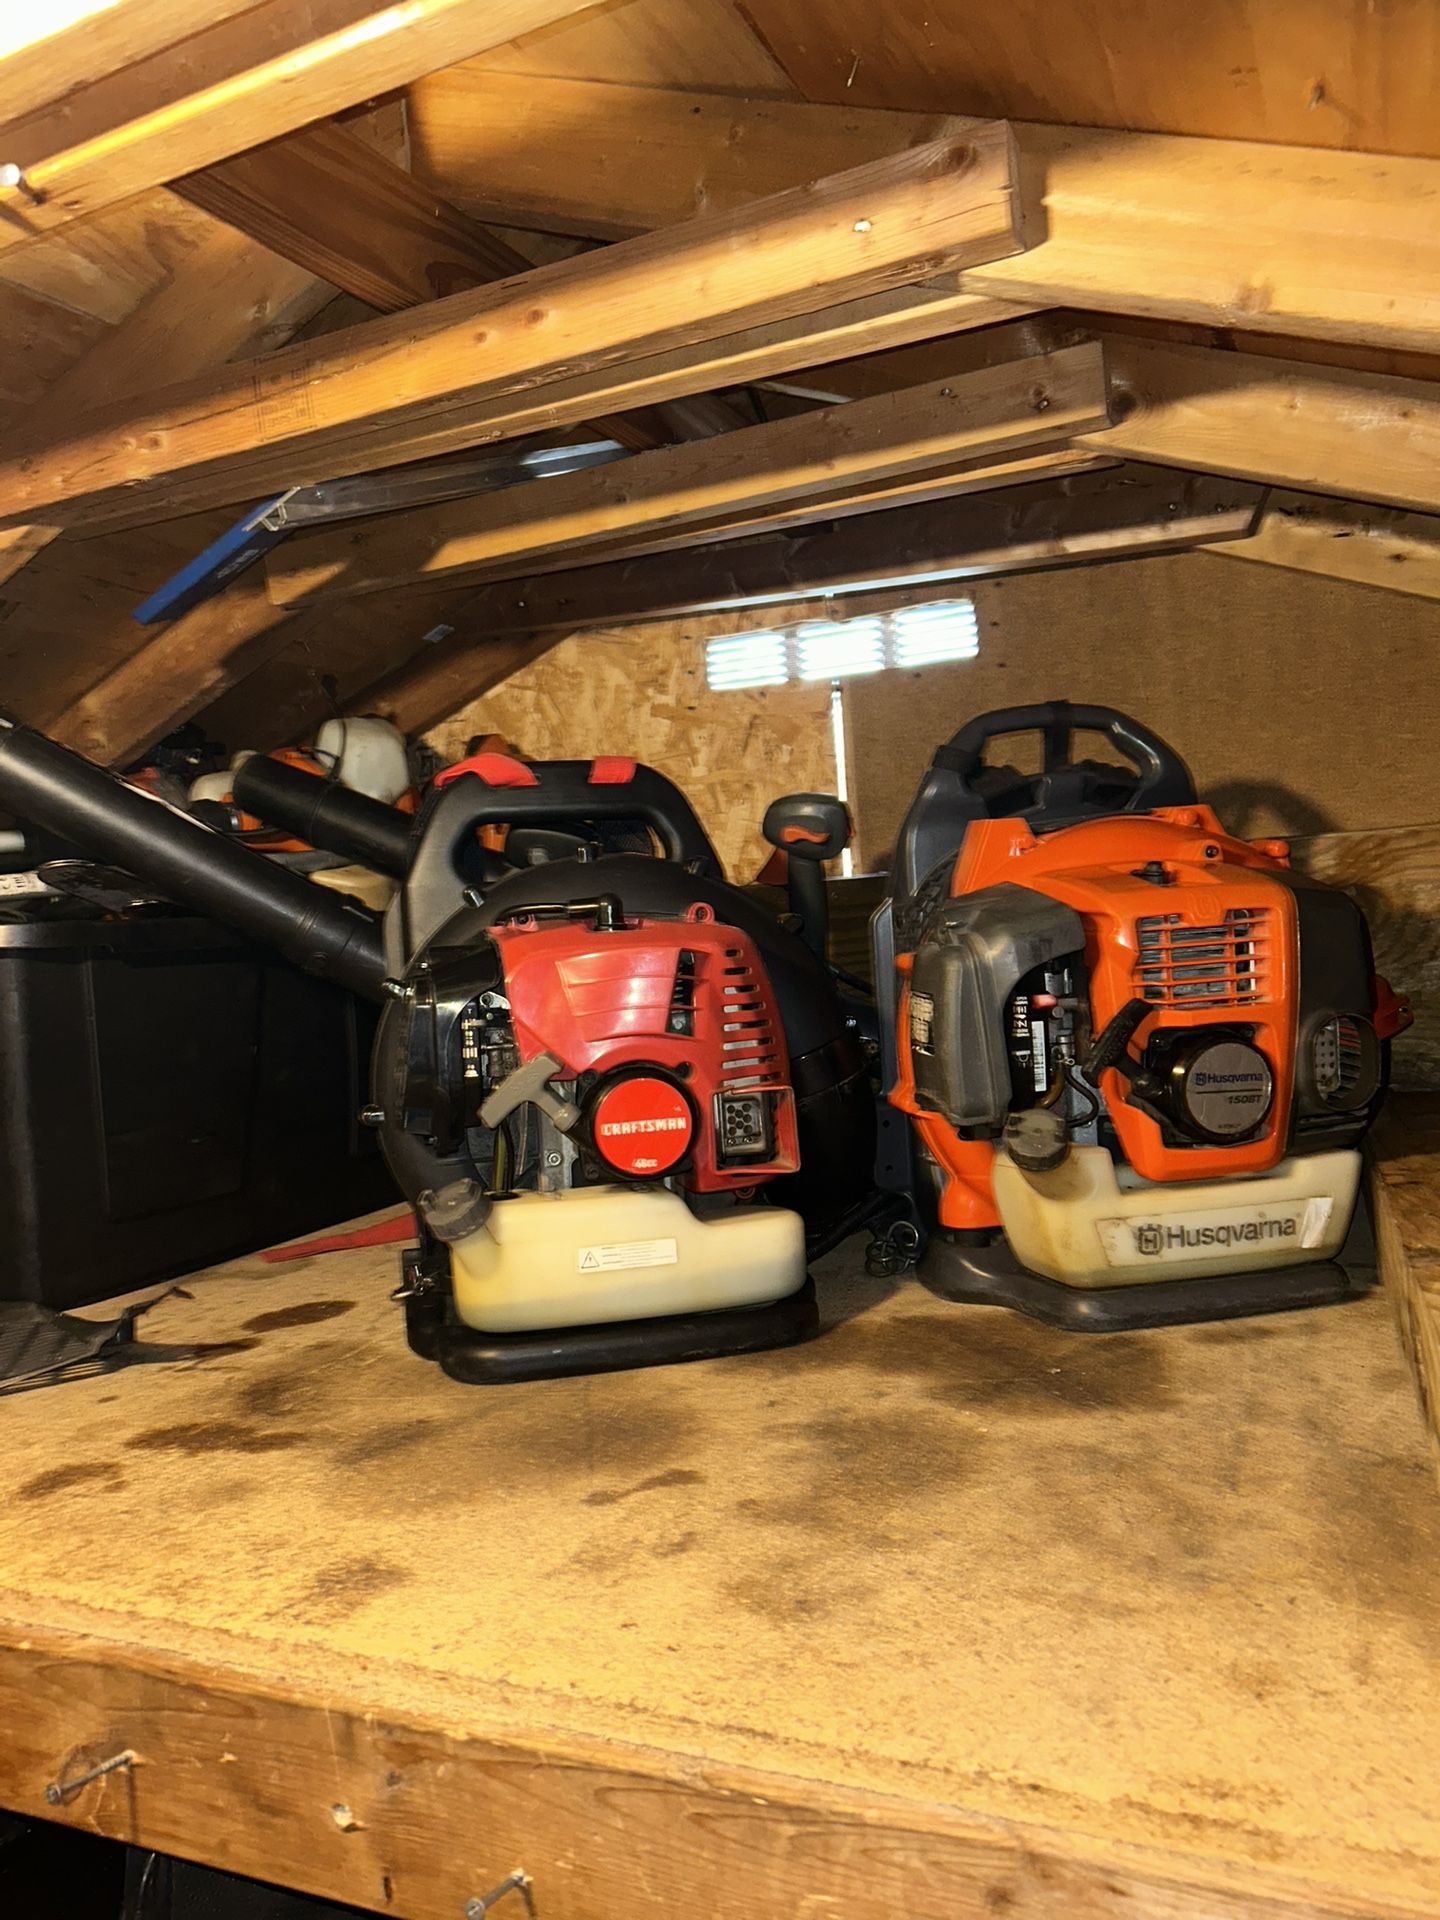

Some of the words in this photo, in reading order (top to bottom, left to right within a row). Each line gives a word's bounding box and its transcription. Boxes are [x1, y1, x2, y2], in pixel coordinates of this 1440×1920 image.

[1208, 1073, 1263, 1084] Husqvarna
[1228, 1094, 1263, 1104] 150BT
[601, 1117, 686, 1135] CRAFTSMAN
[1167, 1217, 1297, 1248] Husqvarna
